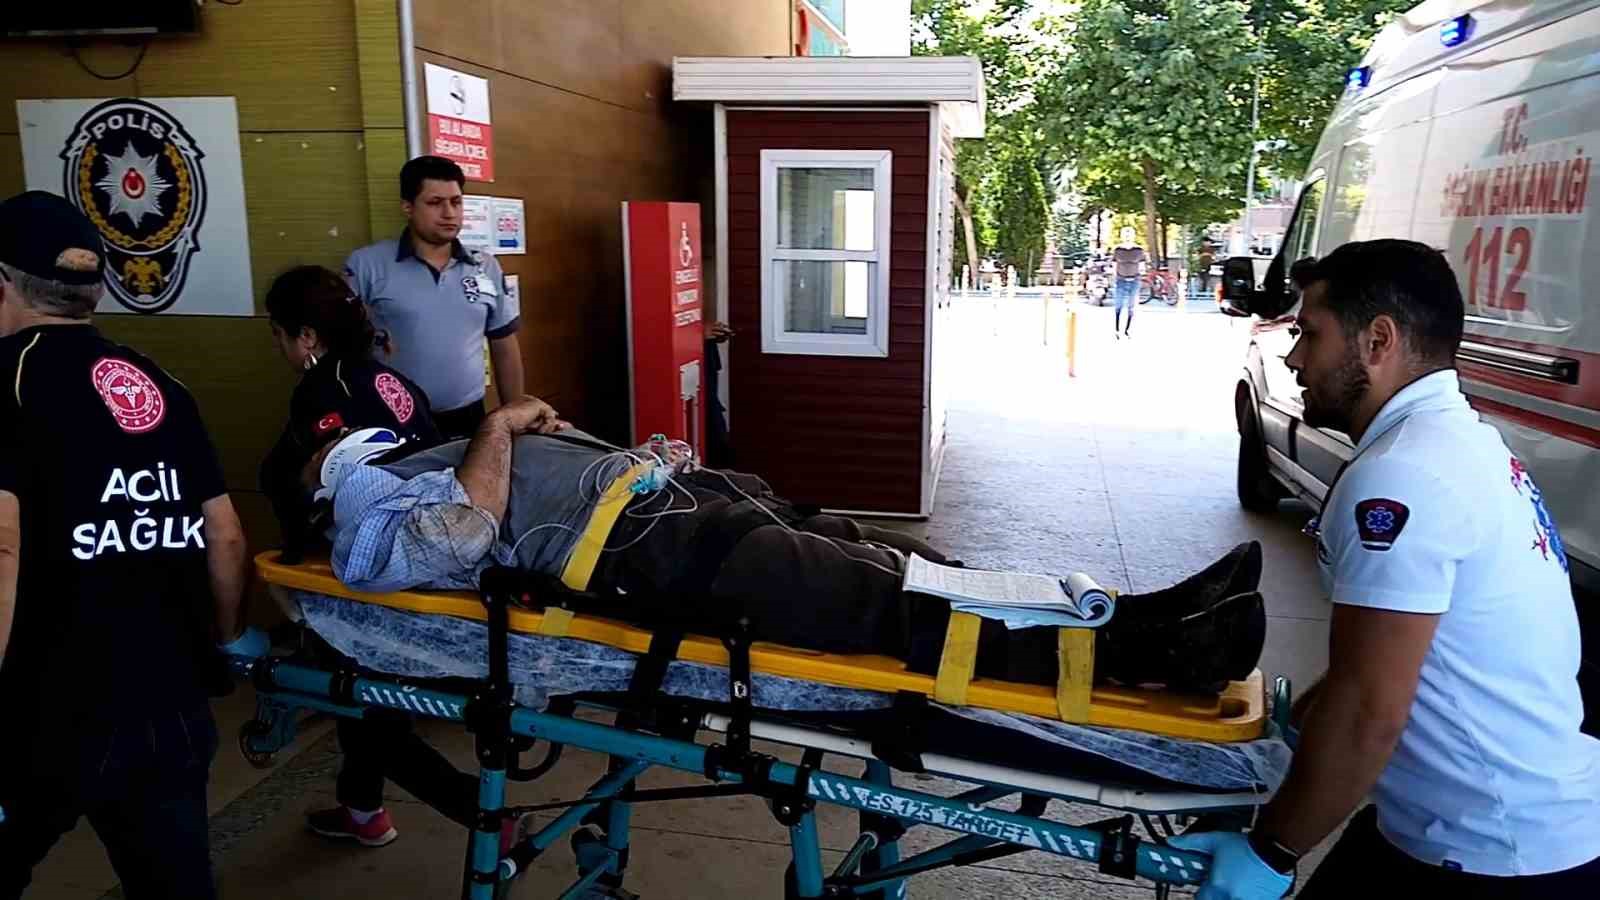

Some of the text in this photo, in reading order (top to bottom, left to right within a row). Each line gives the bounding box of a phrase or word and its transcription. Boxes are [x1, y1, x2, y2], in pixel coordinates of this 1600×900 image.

[92, 112, 165, 140] POLİS
[1464, 226, 1532, 311] 112
[71, 508, 205, 560] SAĞLK
